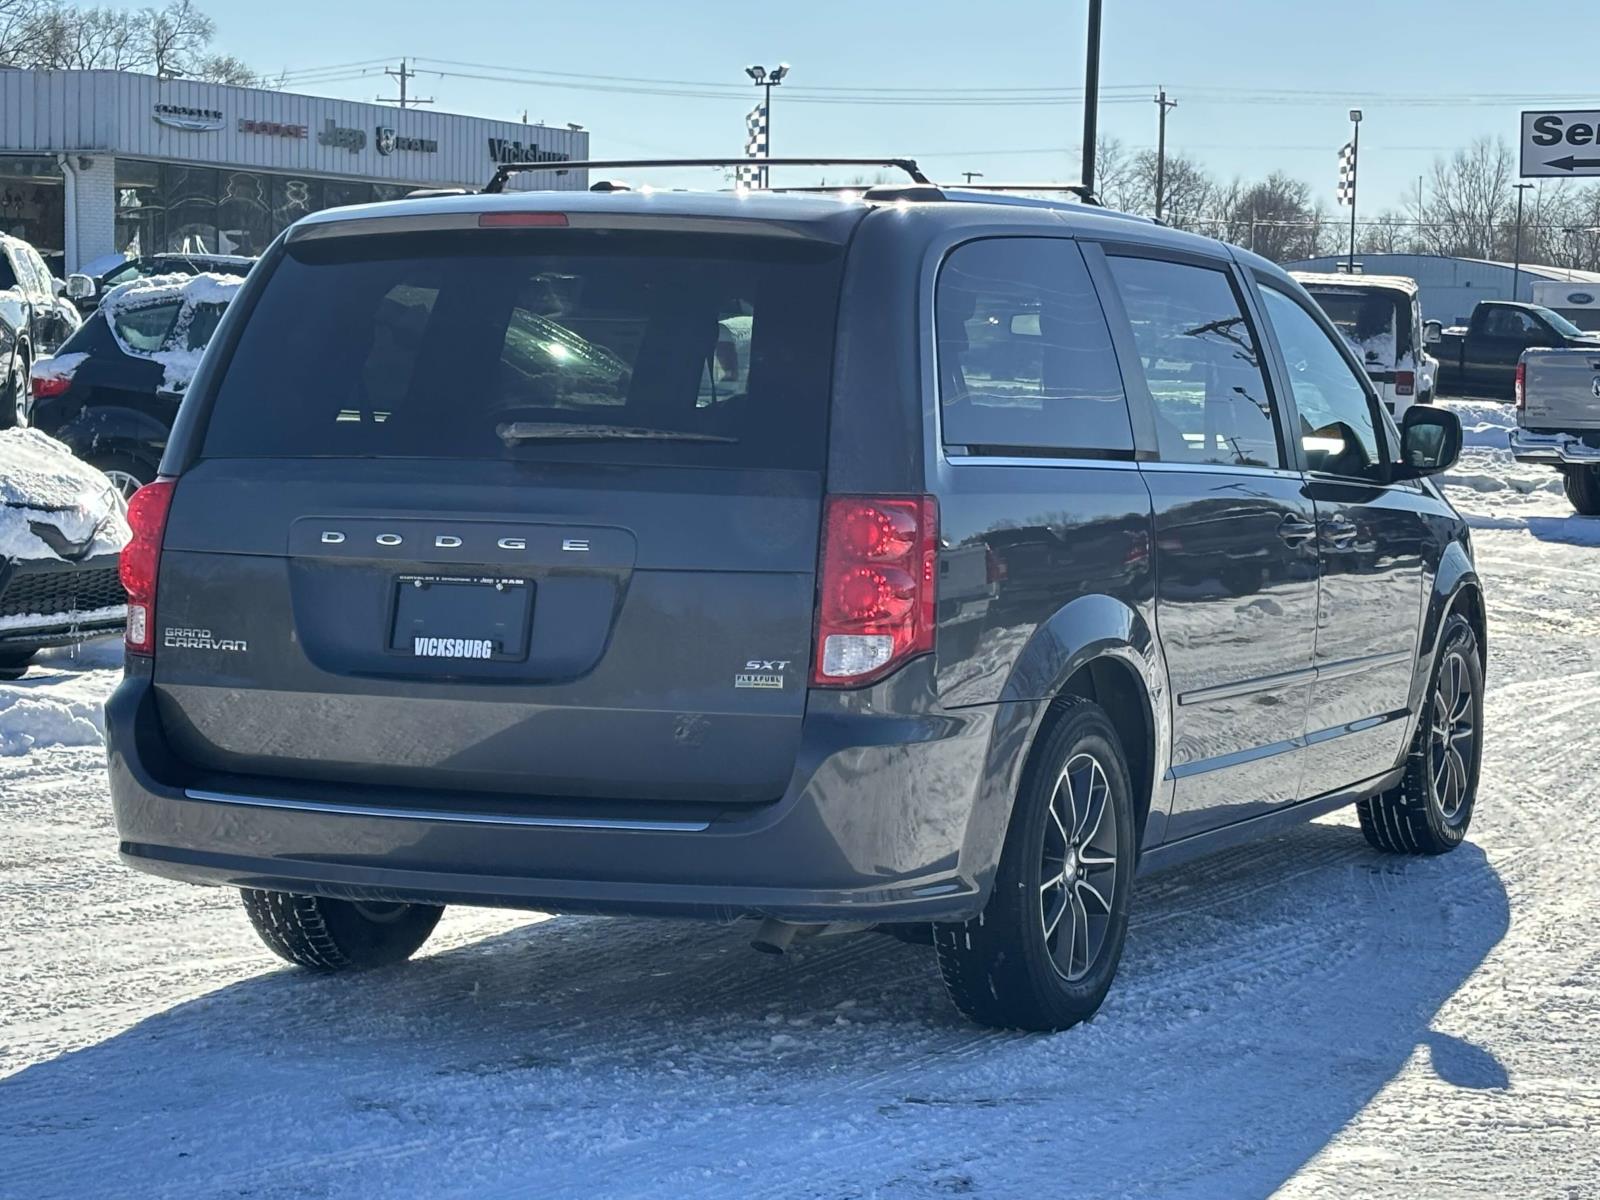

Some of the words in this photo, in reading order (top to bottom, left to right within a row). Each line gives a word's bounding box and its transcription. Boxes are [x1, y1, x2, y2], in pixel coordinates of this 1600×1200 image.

[1532, 115, 1600, 146] Se
[321, 531, 590, 551] DODGE
[164, 627, 212, 638] GRAND
[164, 636, 248, 652] CARAVAN
[414, 637, 493, 659] VICKSBURG
[744, 660, 791, 670] SXT
